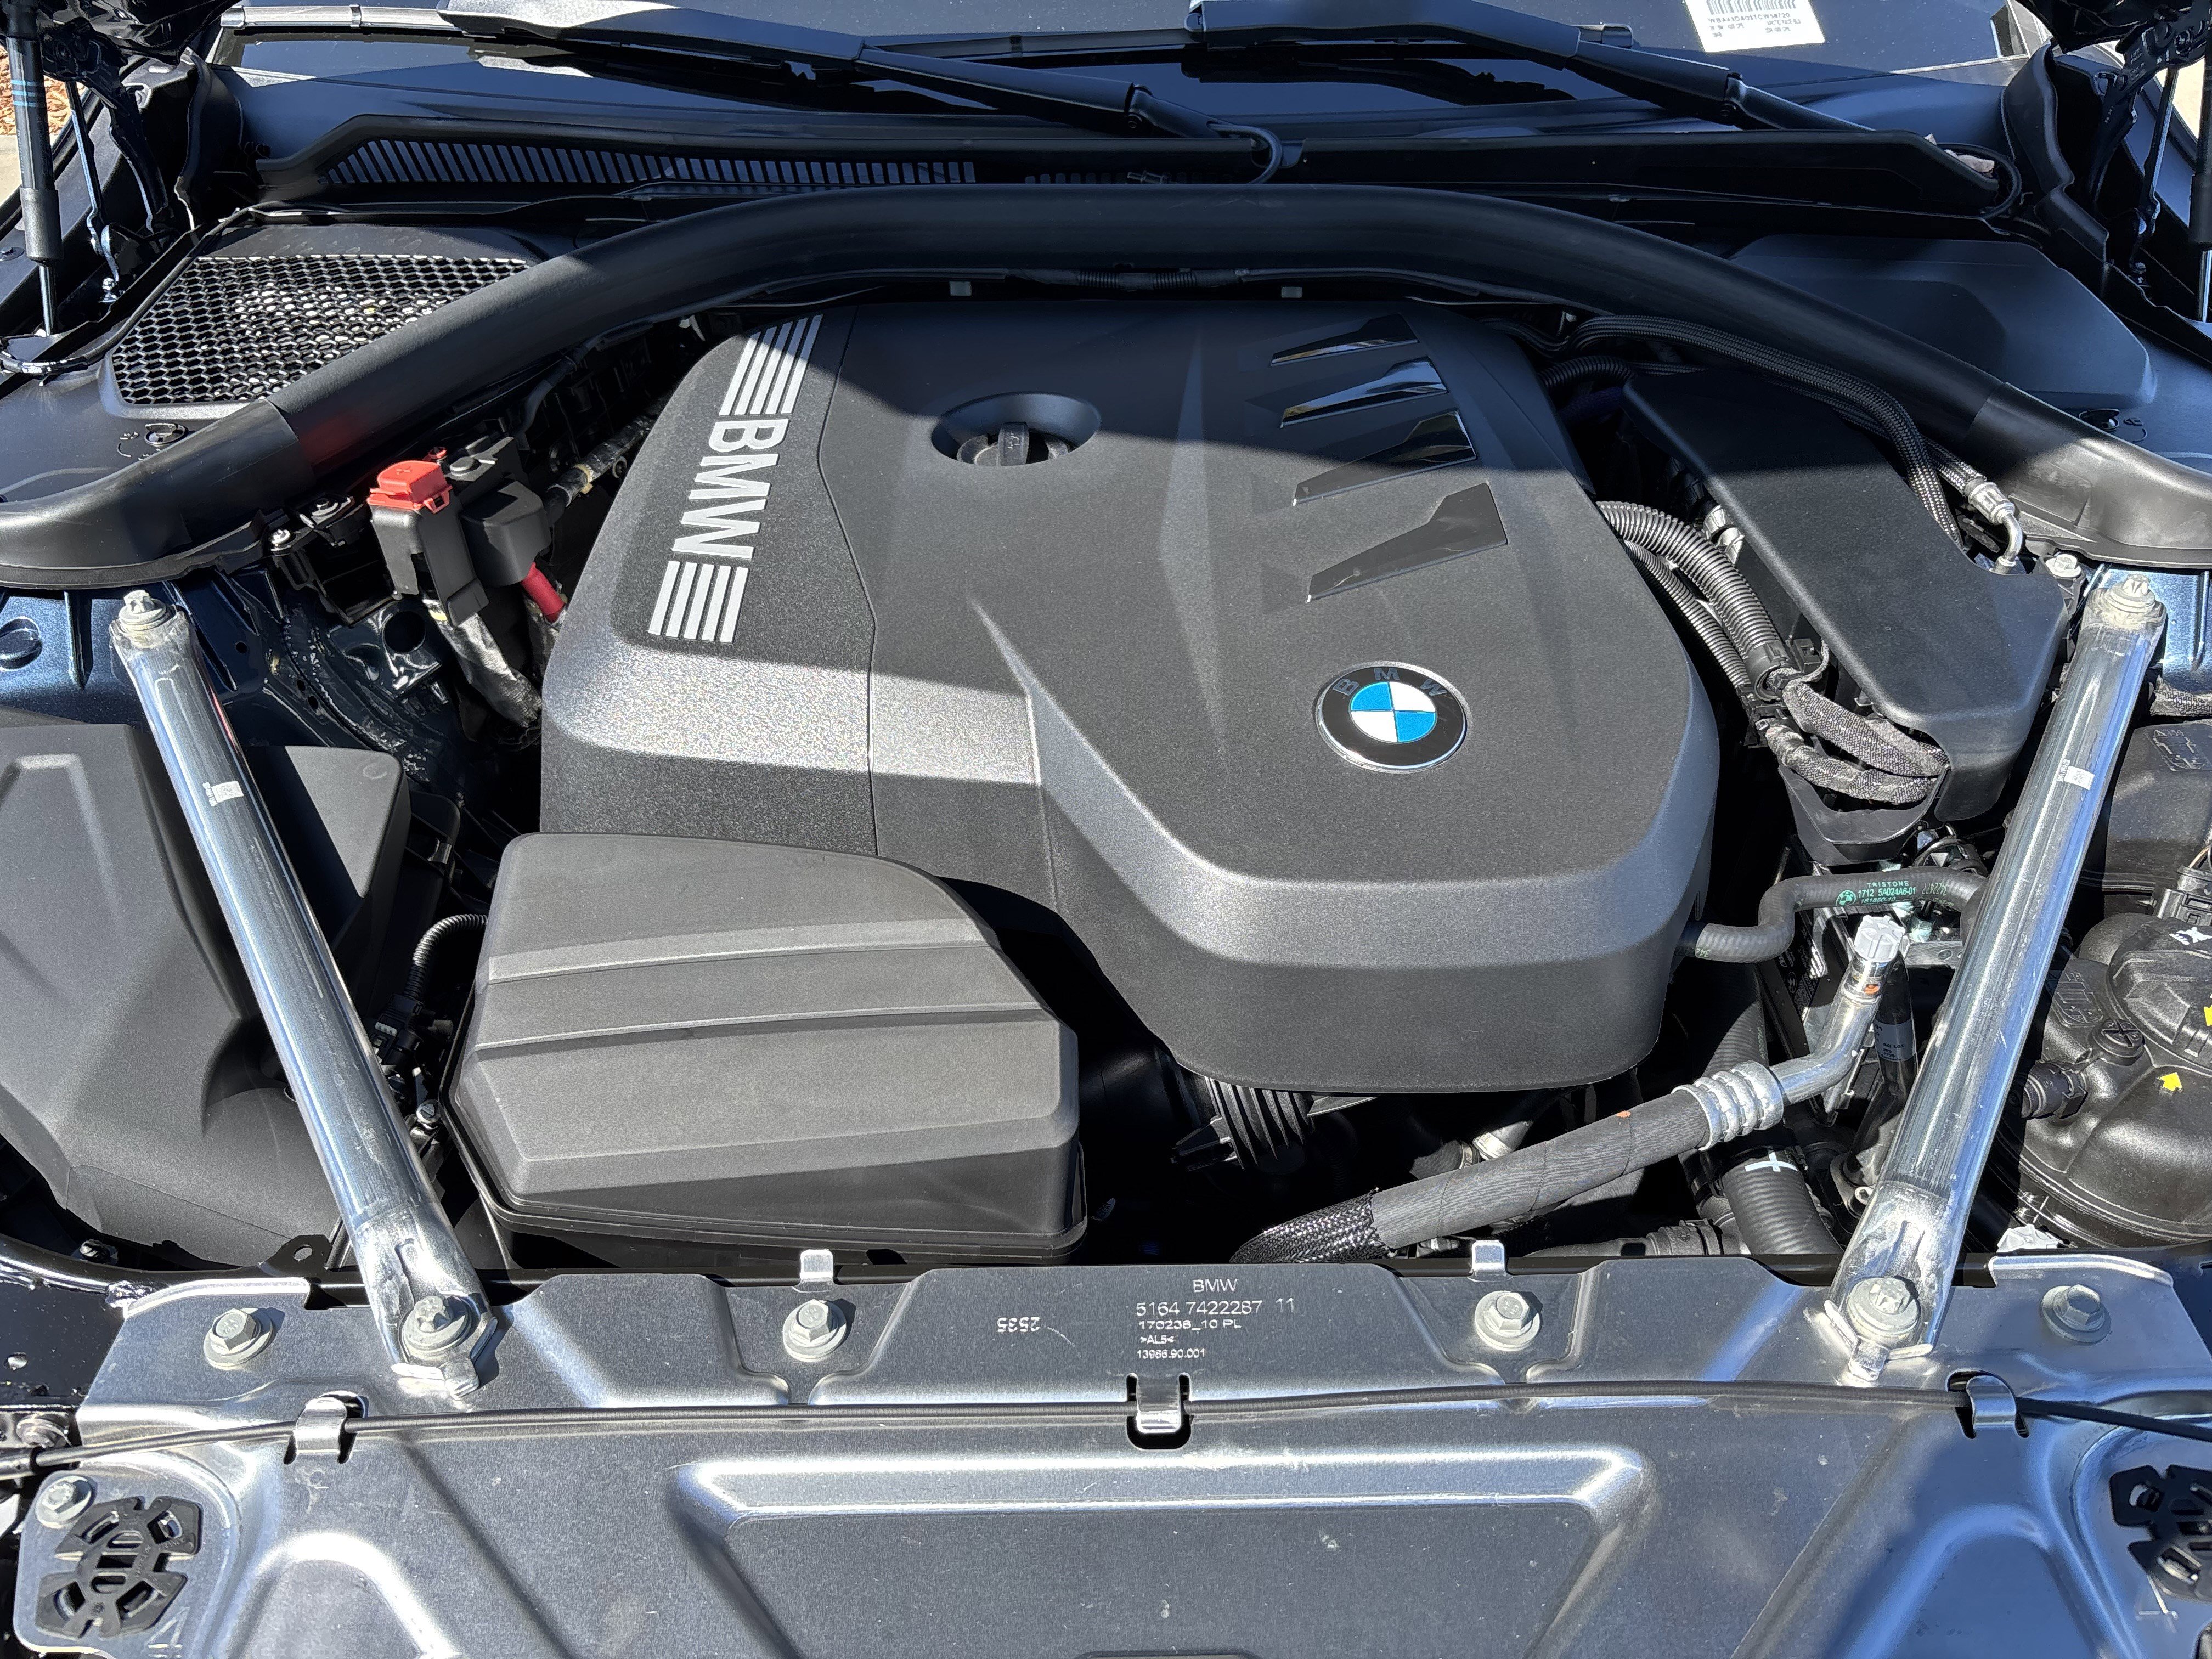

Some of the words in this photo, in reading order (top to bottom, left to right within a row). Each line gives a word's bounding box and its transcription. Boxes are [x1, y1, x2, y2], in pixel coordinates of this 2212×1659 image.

[672, 419, 789, 560] BMW
[1332, 668, 1448, 697] BMW
[1866, 880, 1909, 888] TRISTONE
[1858, 888, 1875, 898] 1712
[1193, 1278, 1239, 1293] BMW
[1135, 1301, 1180, 1317] 5164
[1185, 1300, 1263, 1315] 7422287
[1276, 1297, 1295, 1313] 11
[997, 1317, 1041, 1333] 2535
[1223, 1319, 1242, 1329] PL
[1136, 1348, 1206, 1359] 13986.90.001
